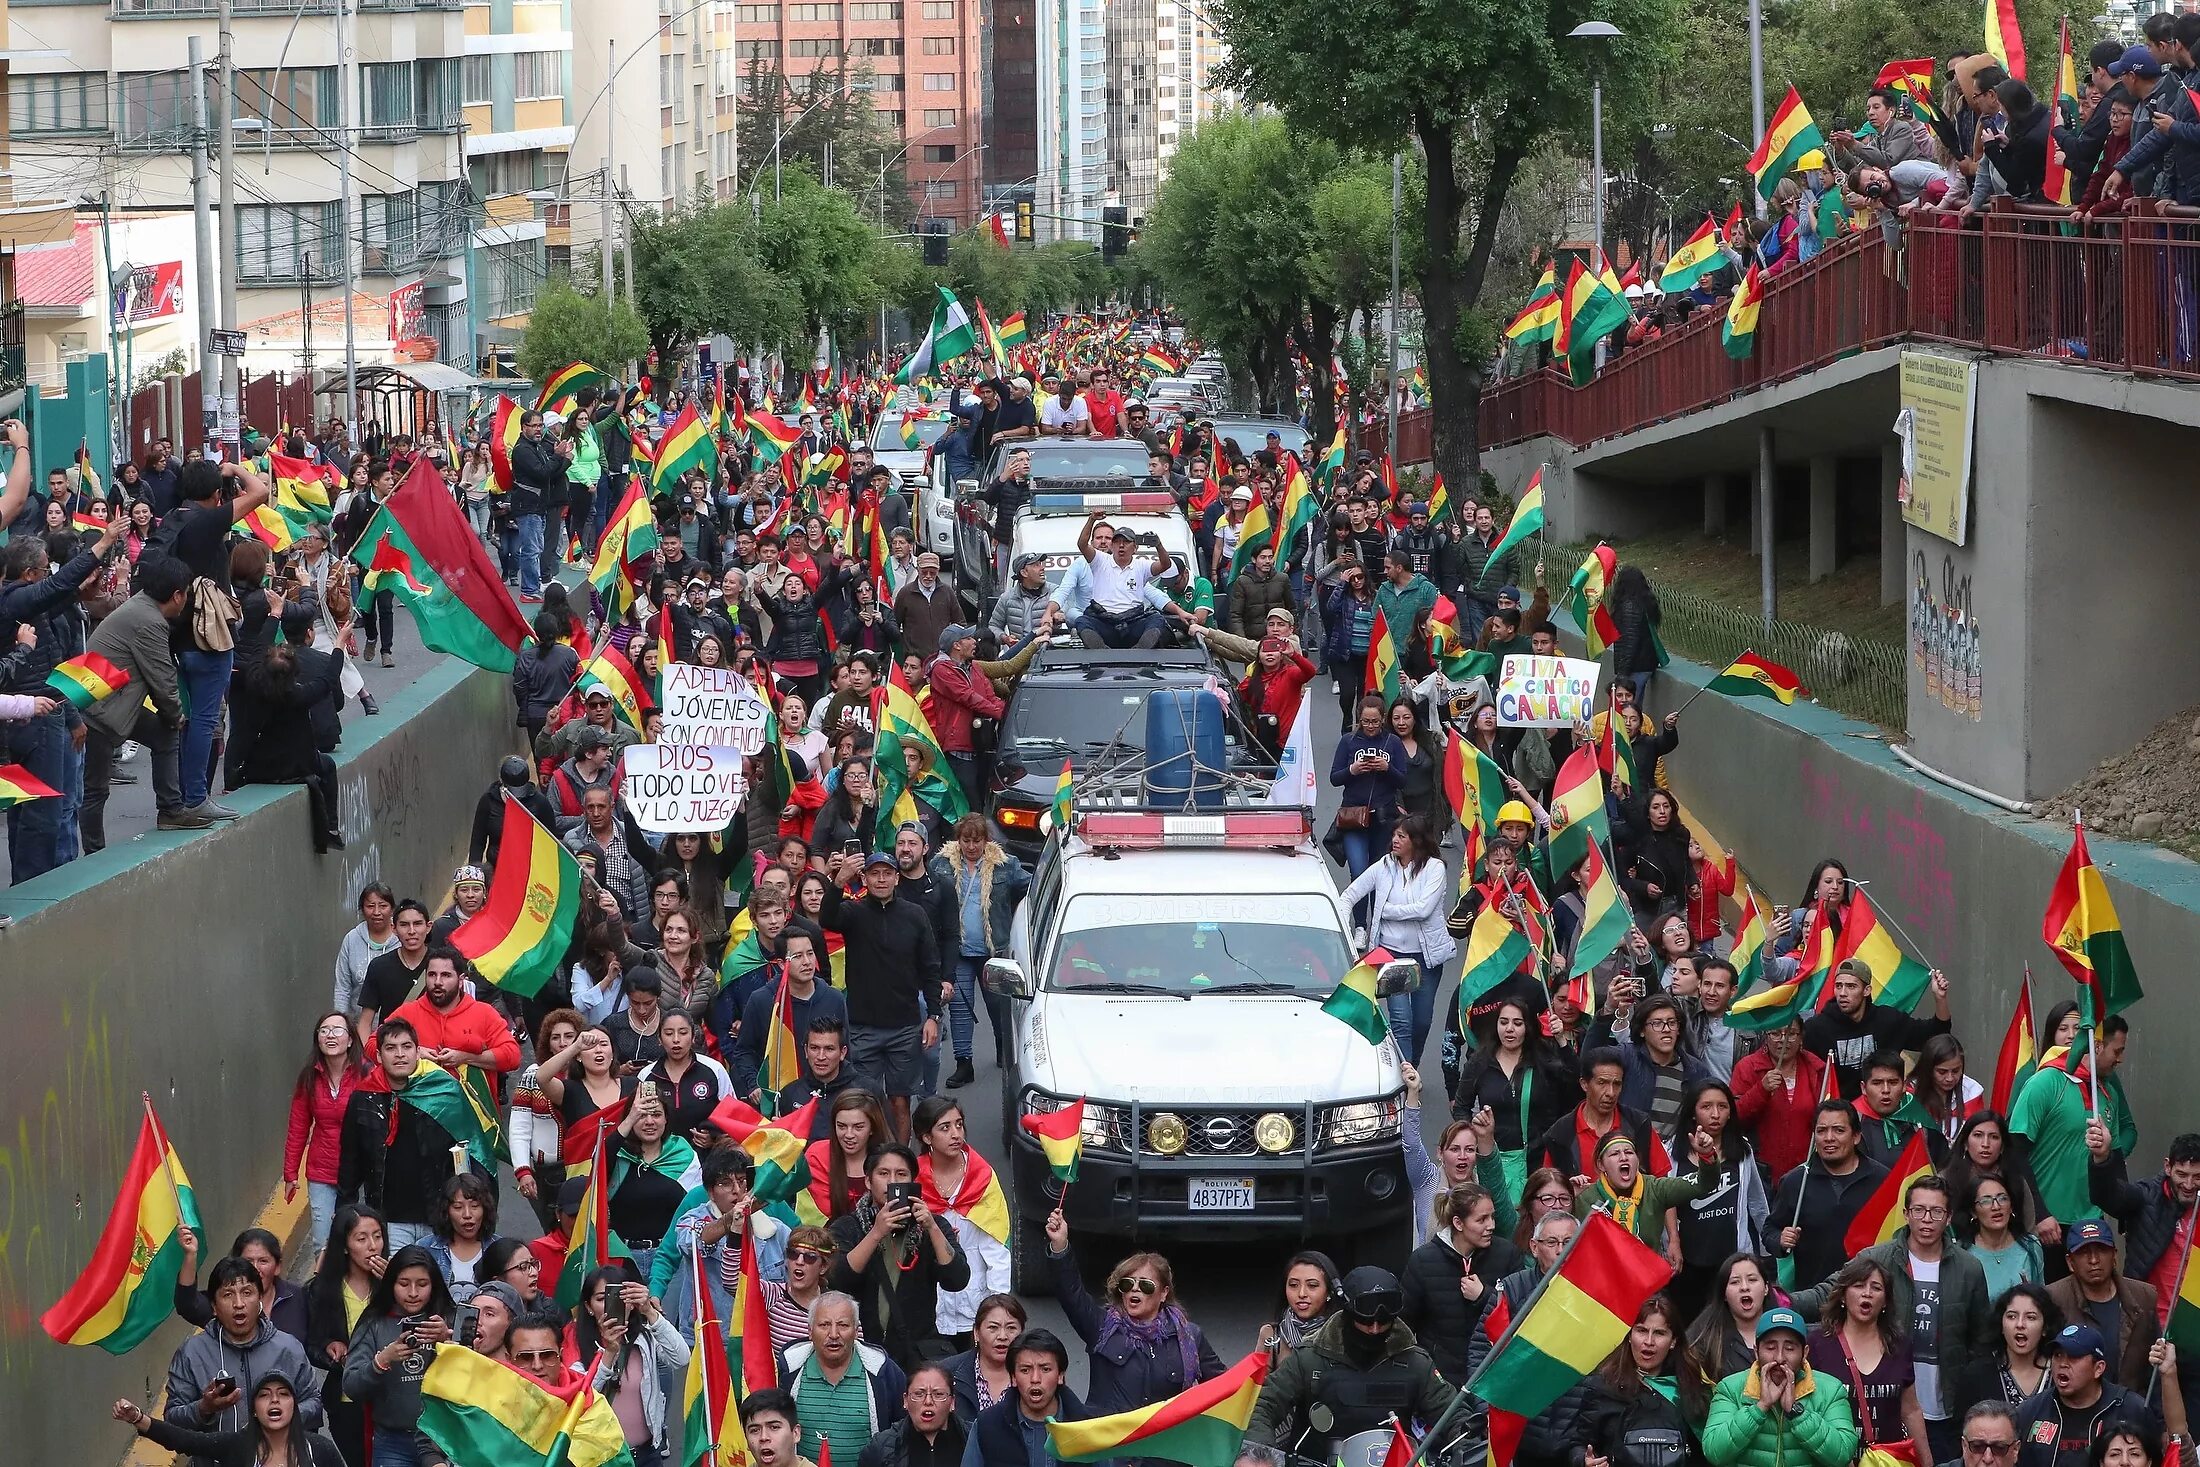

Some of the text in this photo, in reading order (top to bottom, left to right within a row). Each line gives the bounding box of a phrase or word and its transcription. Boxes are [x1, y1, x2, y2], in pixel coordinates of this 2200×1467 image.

[1506, 659, 1566, 678] BOLIVIA
[671, 695, 760, 721] JÓVENES
[1500, 694, 1592, 722] CAMACHO
[662, 724, 765, 753] CON CONCIENCIA
[659, 745, 713, 771] DIOS
[628, 773, 741, 798] TODO LO VE
[638, 800, 737, 823] Y LO JUZGA
[1194, 1189, 1250, 1206] 4837PFX
[1698, 1210, 1714, 1220] JUST
[1716, 1208, 1728, 1216] DO
